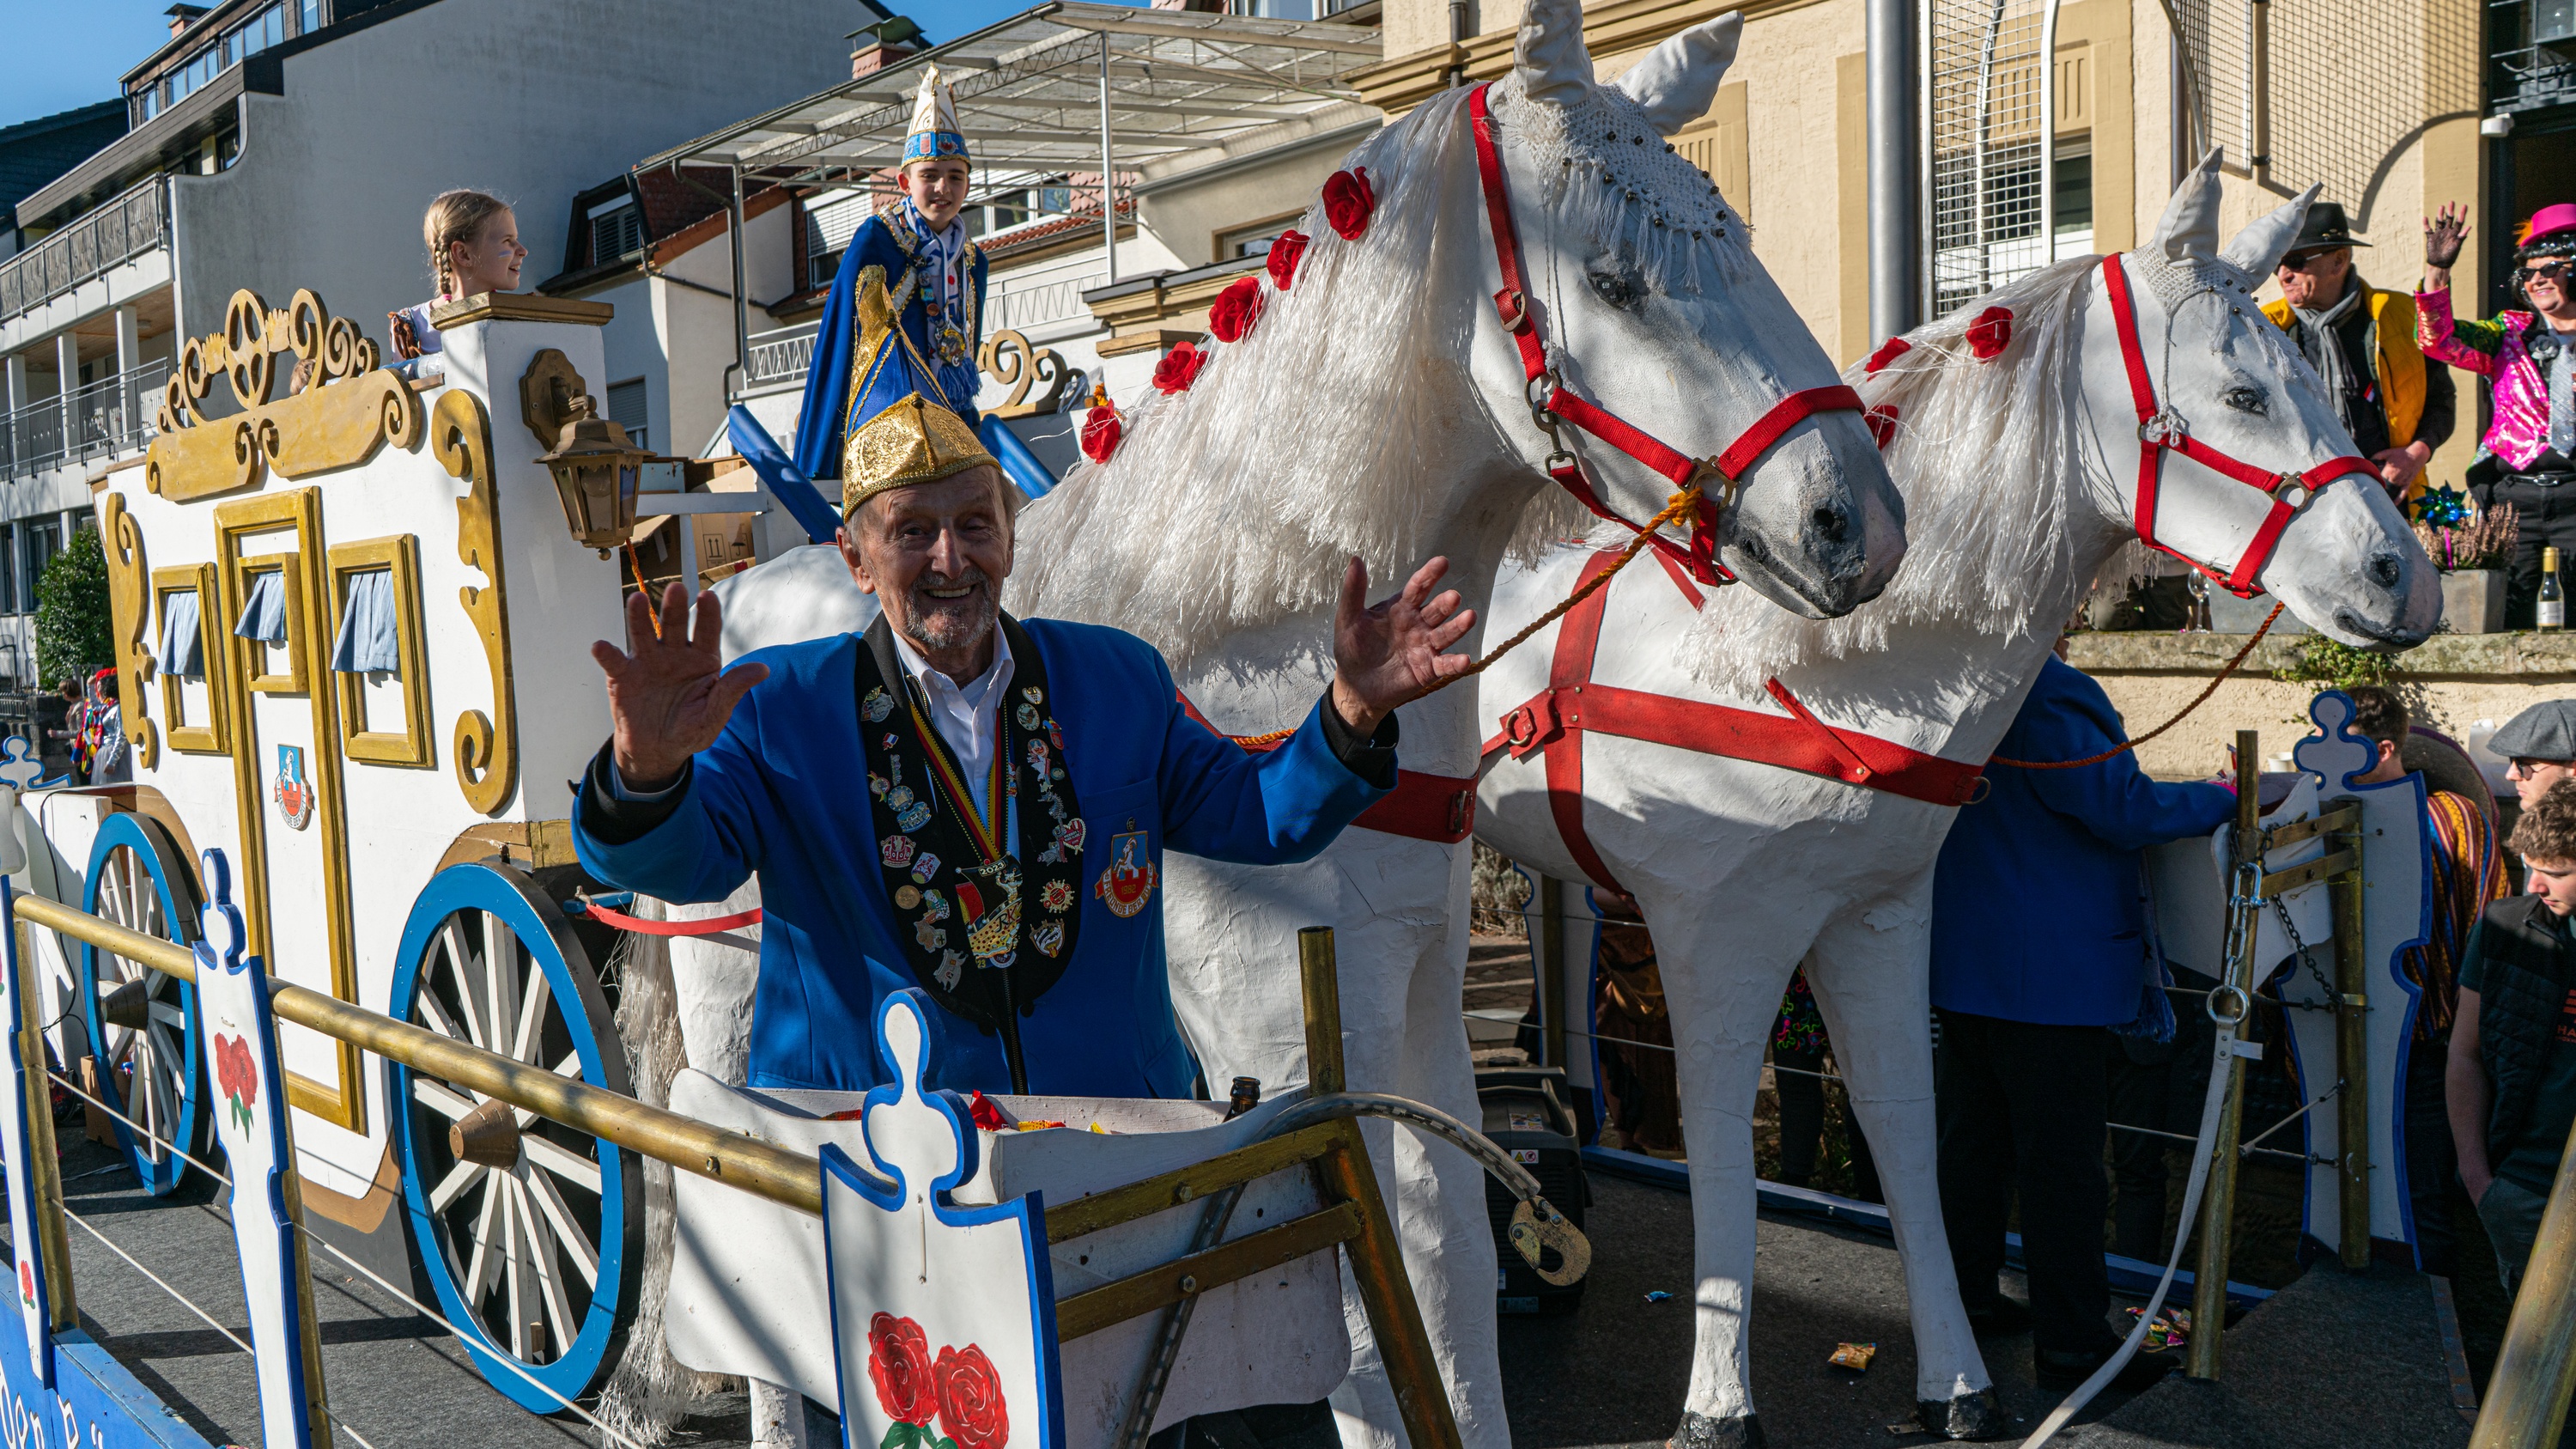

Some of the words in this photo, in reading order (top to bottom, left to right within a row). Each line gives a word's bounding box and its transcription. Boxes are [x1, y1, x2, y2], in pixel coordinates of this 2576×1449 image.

[980, 862, 1005, 875] 2023
[1121, 884, 1137, 896] 1982
[1103, 881, 1127, 915] FREUNDE
[1127, 898, 1144, 914] DER
